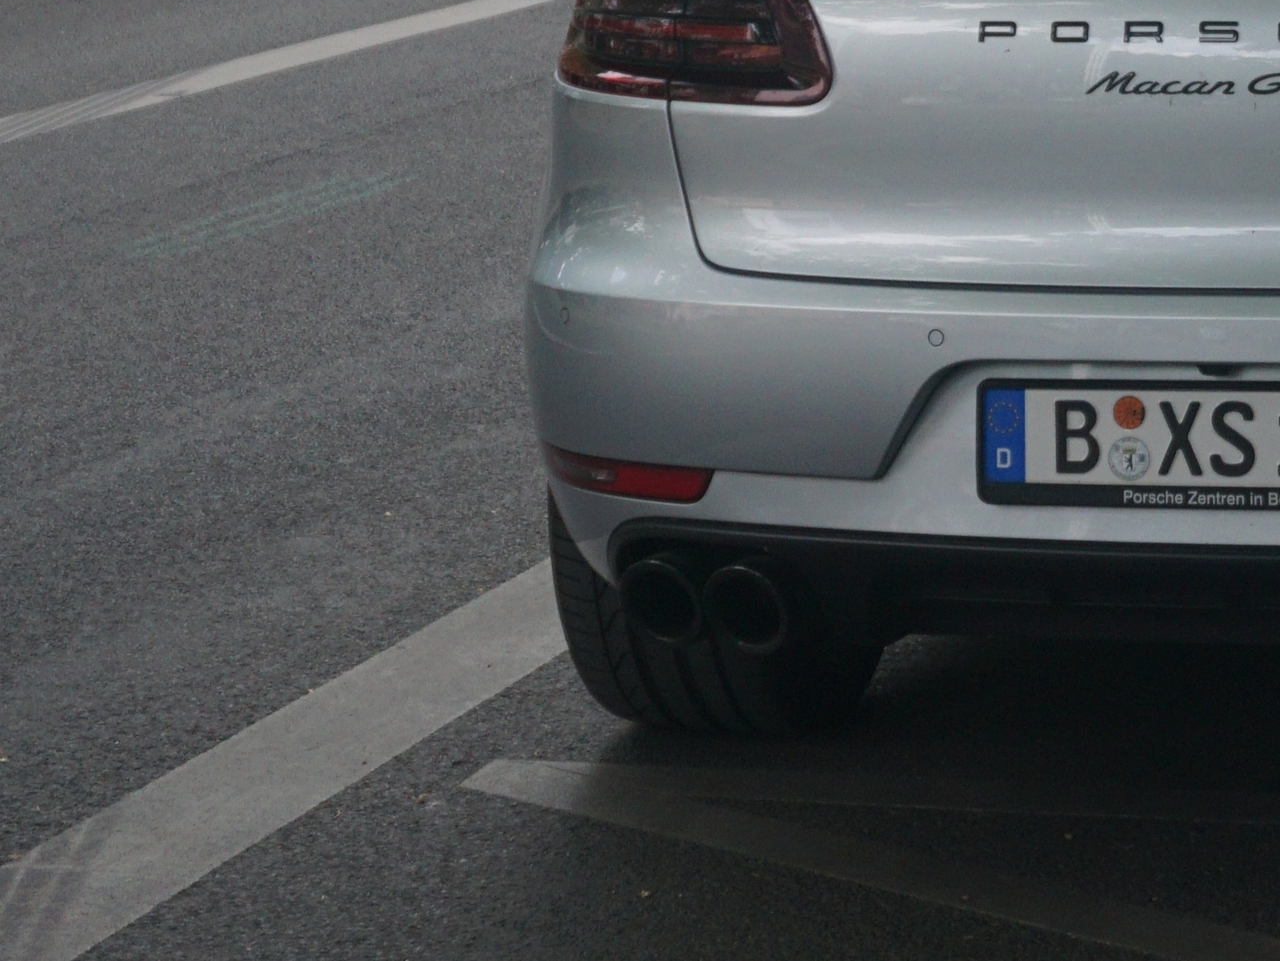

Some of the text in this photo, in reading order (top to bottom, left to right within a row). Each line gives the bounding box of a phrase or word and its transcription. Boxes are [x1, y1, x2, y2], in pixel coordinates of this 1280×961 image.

[1085, 71, 1236, 95] Macan
[996, 448, 1011, 470] D
[1055, 400, 1101, 475] B
[1157, 401, 1256, 478] XS
[1122, 490, 1184, 505] Porsche
[1187, 490, 1245, 506] Zentren
[1249, 491, 1263, 506] in
